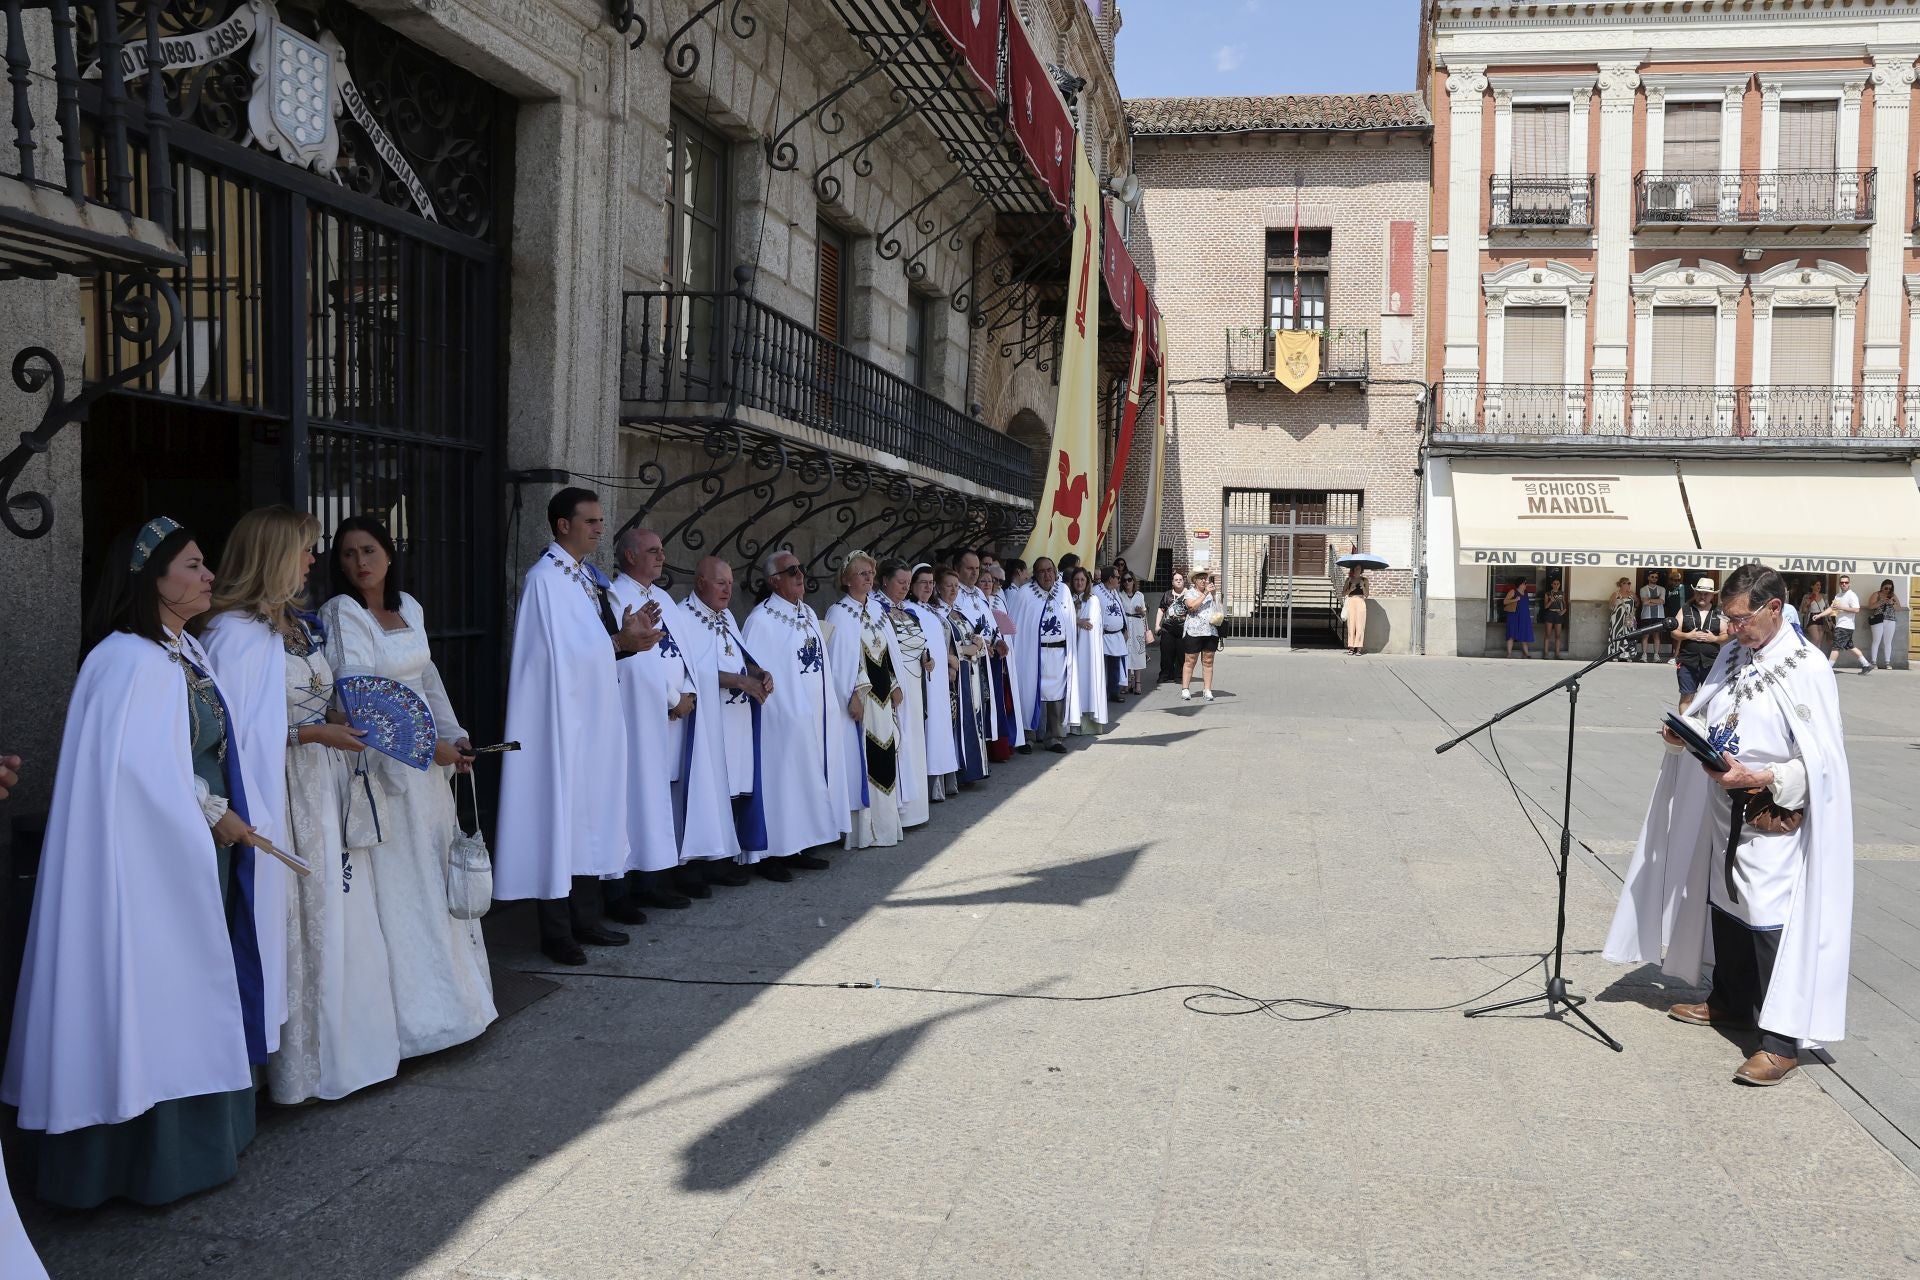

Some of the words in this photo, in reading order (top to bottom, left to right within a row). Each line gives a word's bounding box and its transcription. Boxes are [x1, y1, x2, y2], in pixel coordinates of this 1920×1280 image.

[207, 18, 249, 57] CASAS
[342, 80, 430, 211] CONSISTORIALES
[1524, 483, 1538, 496] LOS
[1539, 482, 1597, 496] CHICOS
[1598, 483, 1611, 495] DEL
[1527, 496, 1615, 514] MANDIL
[1474, 551, 1517, 564] PAN
[1531, 551, 1601, 566] QUESO
[1615, 553, 1762, 569] CHARCUTERIA
[1779, 558, 1857, 573] JAMON
